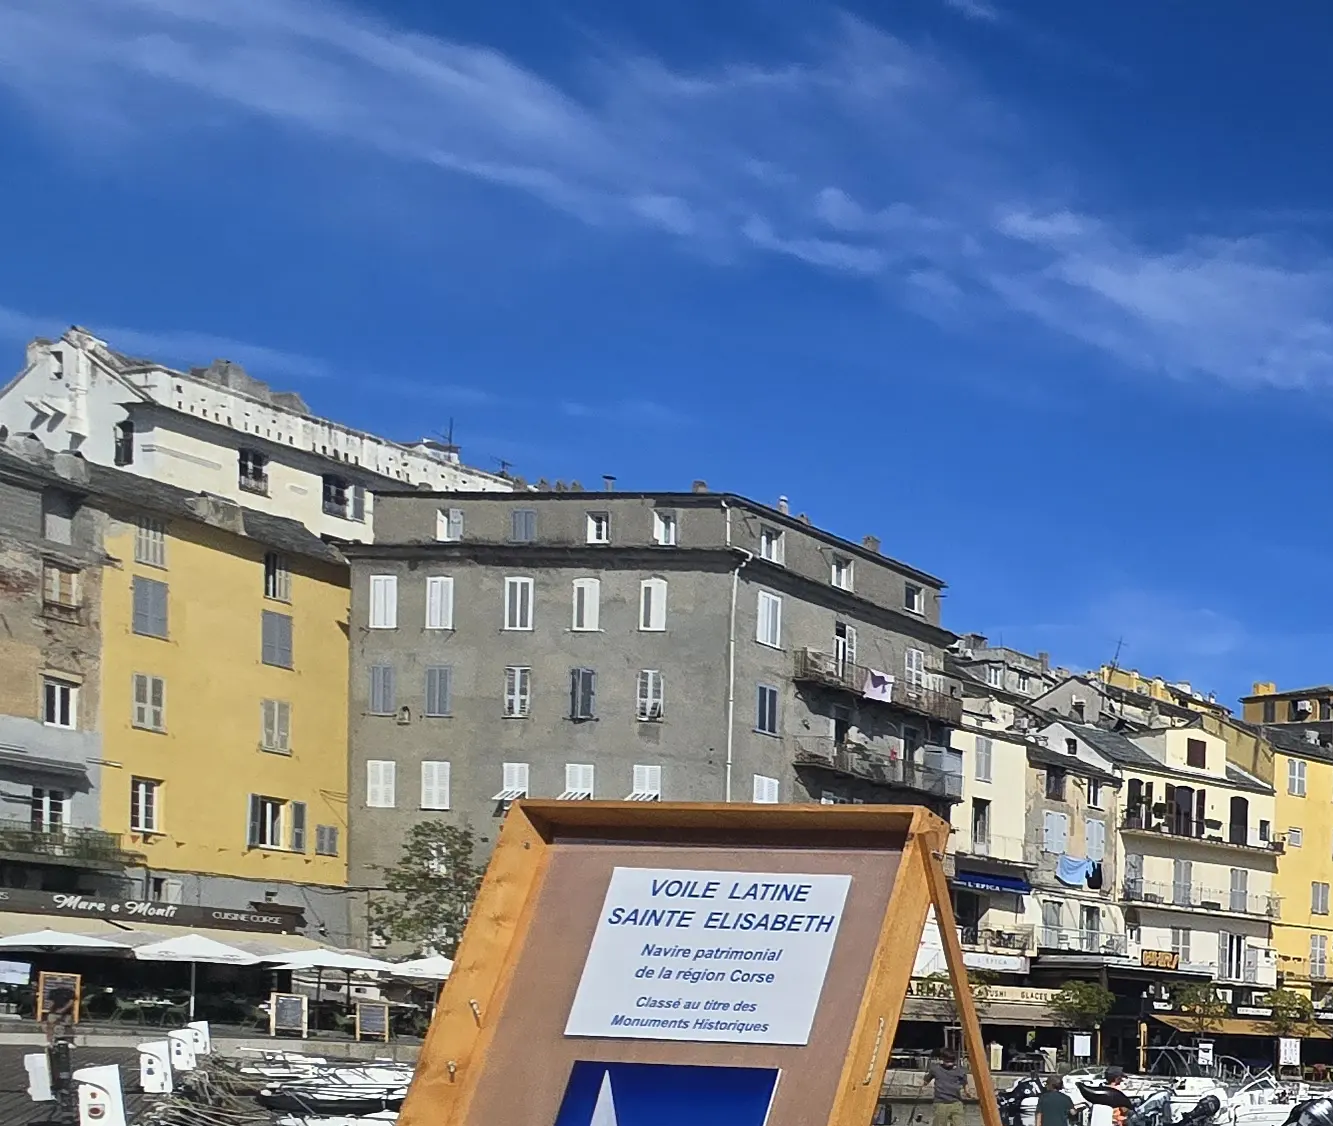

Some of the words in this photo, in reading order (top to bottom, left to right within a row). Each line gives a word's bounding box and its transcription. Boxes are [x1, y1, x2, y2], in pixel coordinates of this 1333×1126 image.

[651, 879, 720, 899] VOILE
[728, 882, 812, 902] LATINE
[53, 894, 105, 913] Mare
[111, 903, 120, 913] e
[125, 901, 176, 918] Monti
[212, 911, 249, 922] CUISINE
[250, 914, 282, 925] CORSE
[608, 907, 696, 929] SAINTE
[704, 911, 835, 933] ELISABETH
[640, 943, 691, 958] Navire
[692, 946, 783, 962] patrimonial
[634, 966, 654, 979] de
[657, 966, 672, 980] la
[675, 967, 725, 984] région
[729, 969, 775, 984] Corse
[635, 996, 682, 1010] Classé
[683, 1000, 700, 1010] au
[703, 999, 730, 1012] titre
[732, 1000, 757, 1013] des
[610, 1014, 690, 1030] Monuments
[692, 1018, 770, 1034] Historiques
